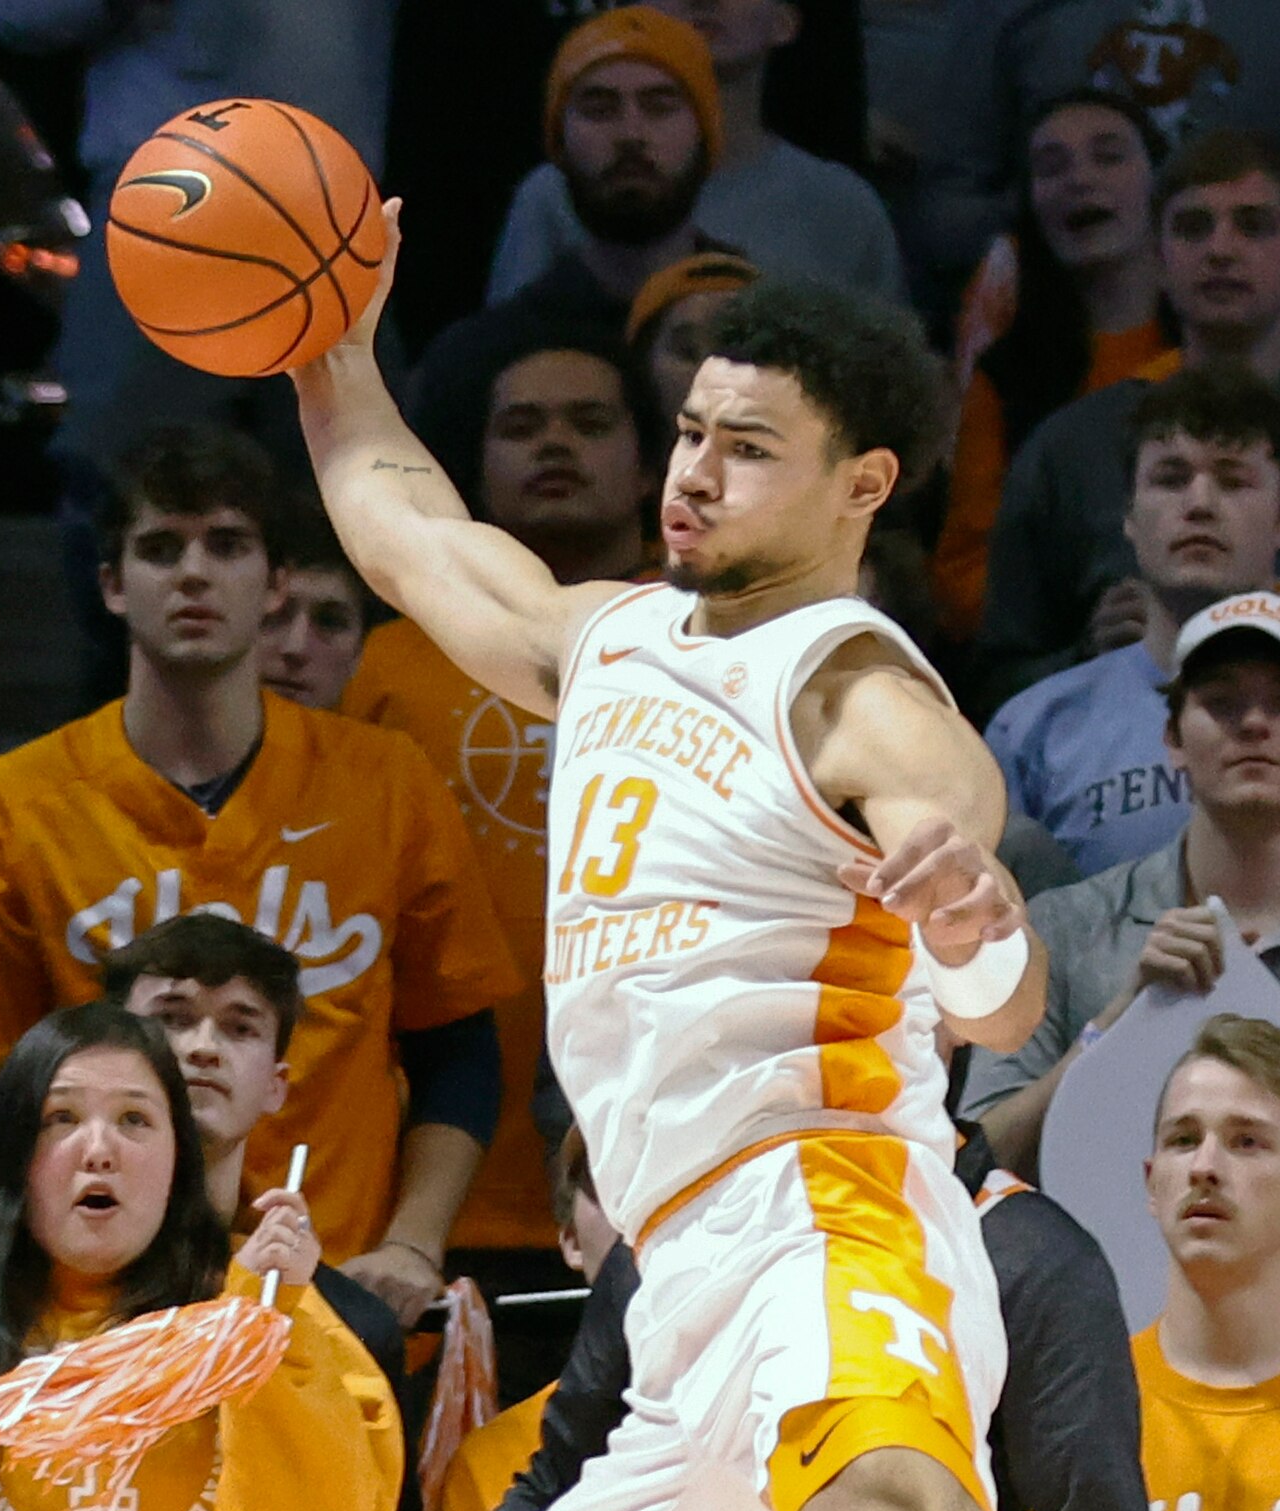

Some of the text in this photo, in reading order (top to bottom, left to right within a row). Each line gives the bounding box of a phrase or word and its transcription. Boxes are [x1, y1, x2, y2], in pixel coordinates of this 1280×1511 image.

[562, 695, 754, 802] TENNESSEE
[557, 773, 660, 898] 13
[848, 1288, 950, 1377] T
